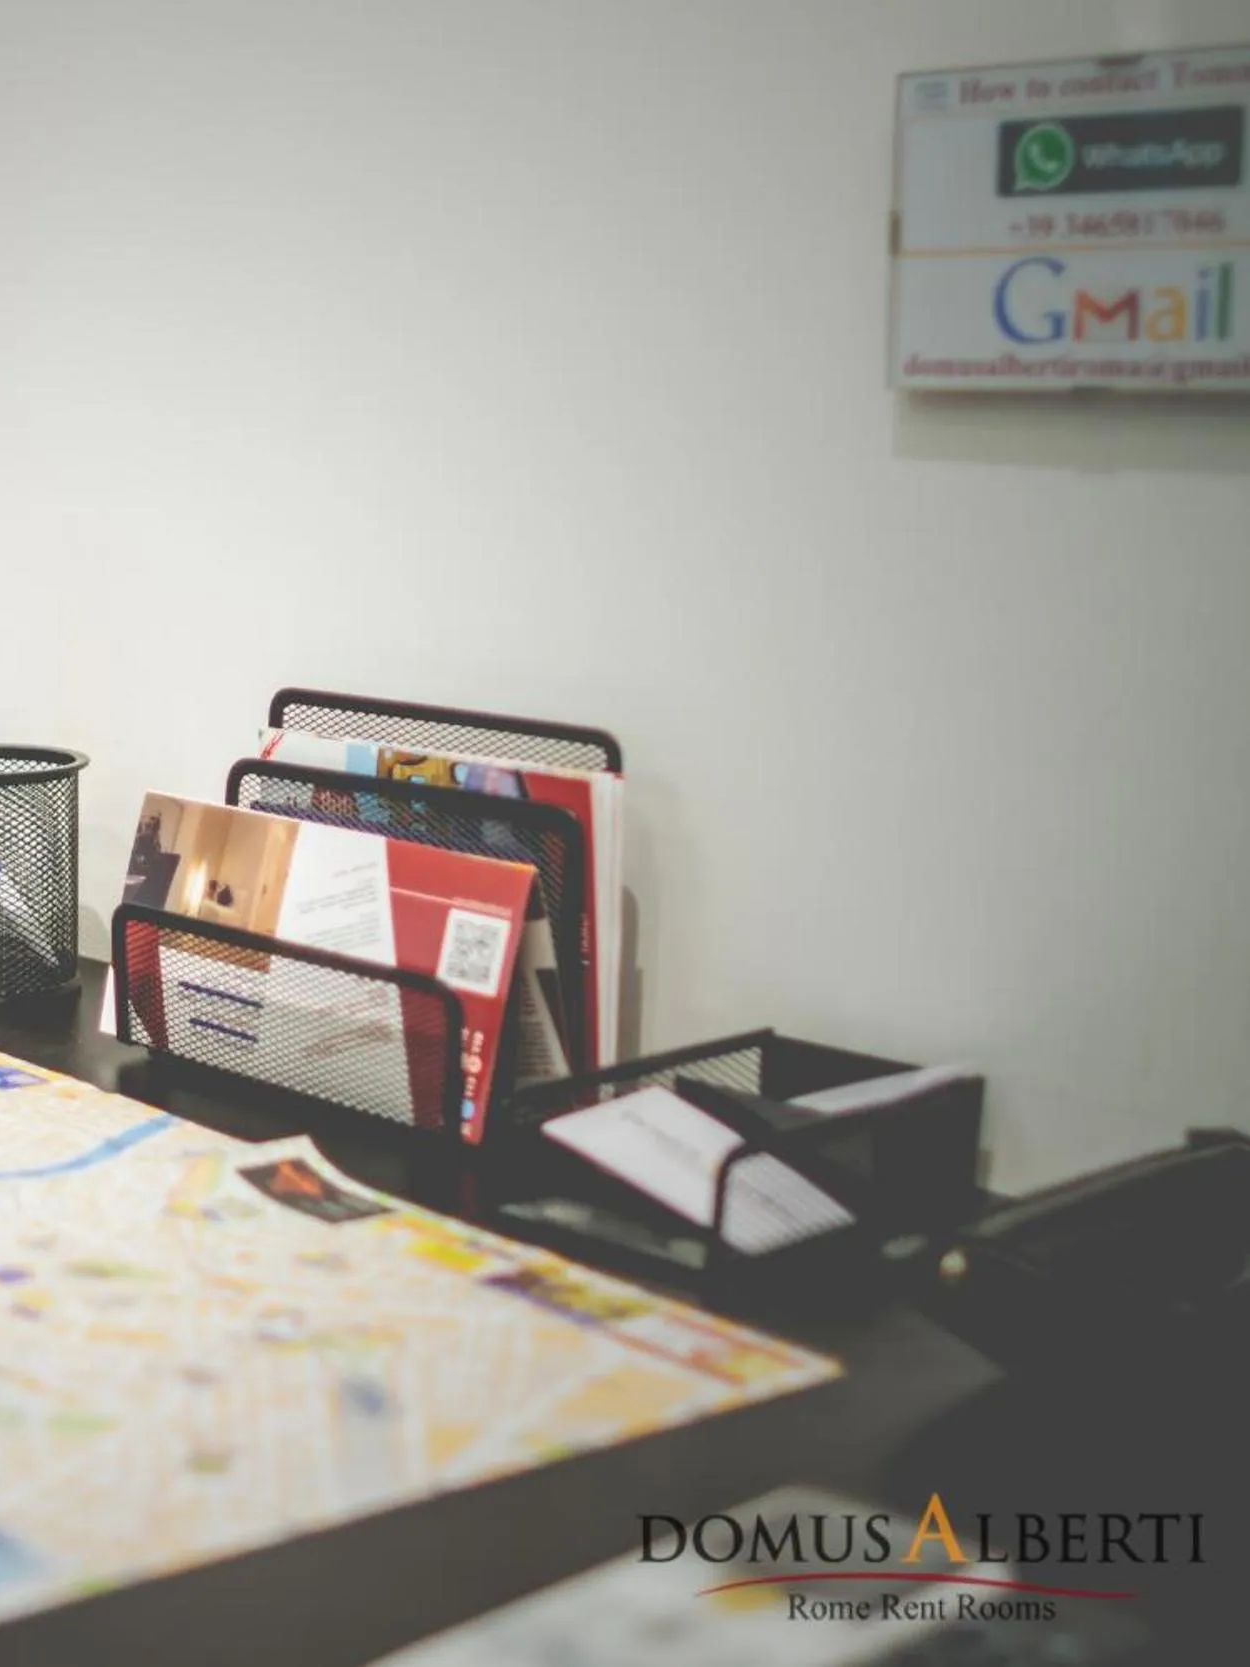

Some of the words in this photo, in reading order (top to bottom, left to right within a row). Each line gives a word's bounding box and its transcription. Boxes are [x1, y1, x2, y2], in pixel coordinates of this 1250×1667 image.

[958, 78, 1016, 105] How
[1025, 79, 1051, 100] to
[1058, 71, 1158, 99] contact
[1082, 137, 1227, 171] WhatsApp
